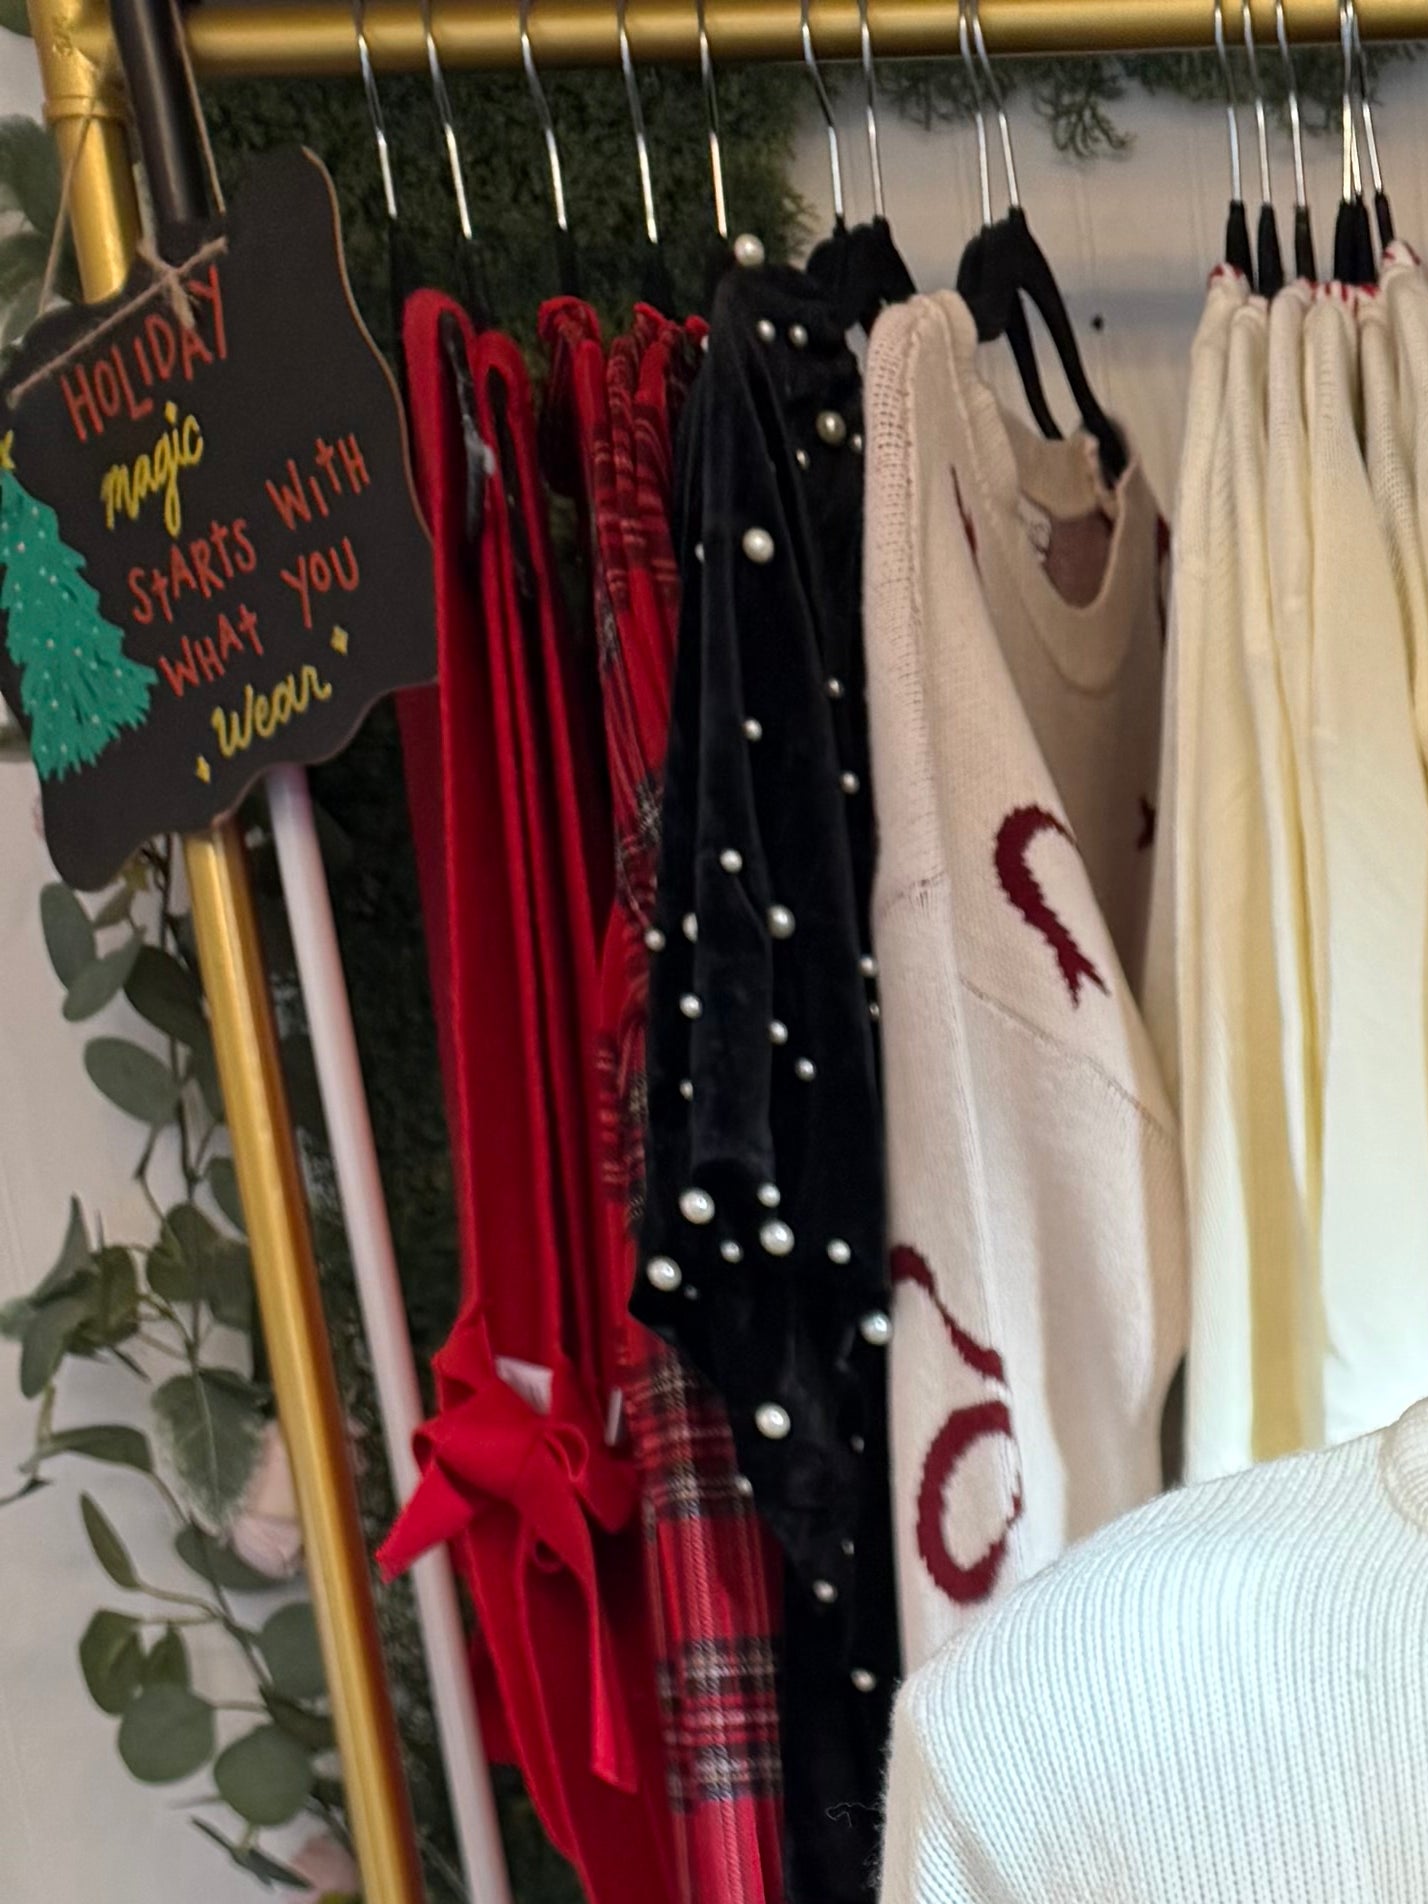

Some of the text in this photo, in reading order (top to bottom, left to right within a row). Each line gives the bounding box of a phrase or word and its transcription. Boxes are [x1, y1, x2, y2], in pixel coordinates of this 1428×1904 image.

[61, 264, 229, 442] HOLIDAY
[100, 401, 205, 538] magic
[281, 538, 361, 628] YOU
